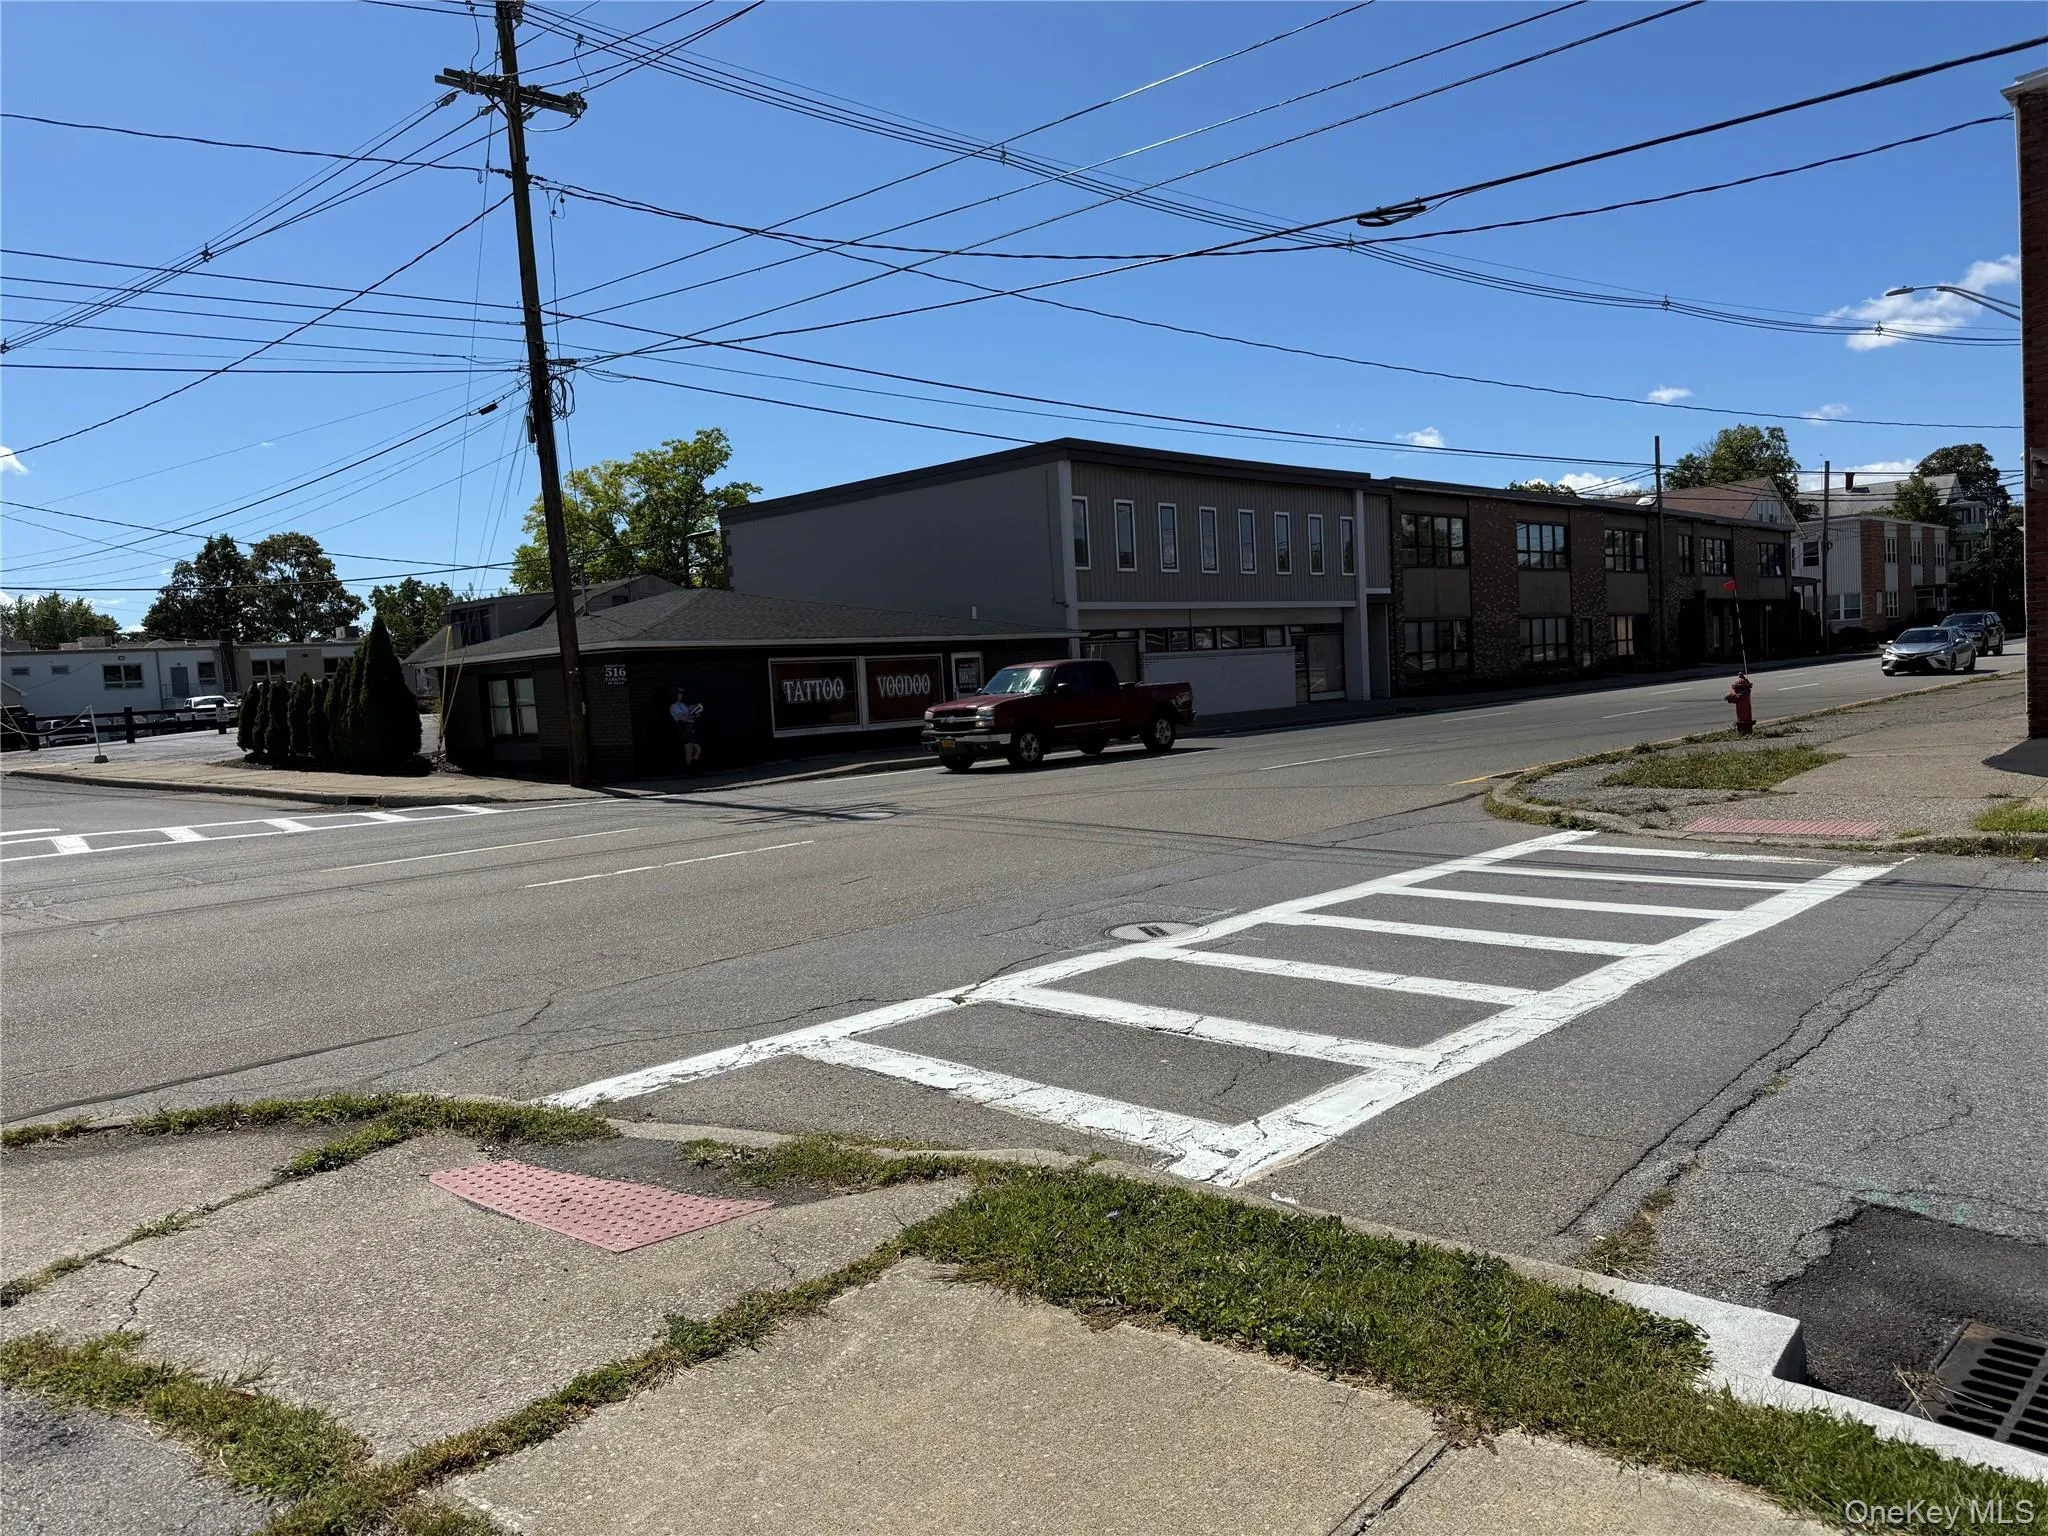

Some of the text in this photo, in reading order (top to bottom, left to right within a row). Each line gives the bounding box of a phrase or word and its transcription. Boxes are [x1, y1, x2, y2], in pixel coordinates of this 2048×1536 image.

[605, 667, 626, 677] 516
[783, 674, 931, 702] TATTOO VOODOO
